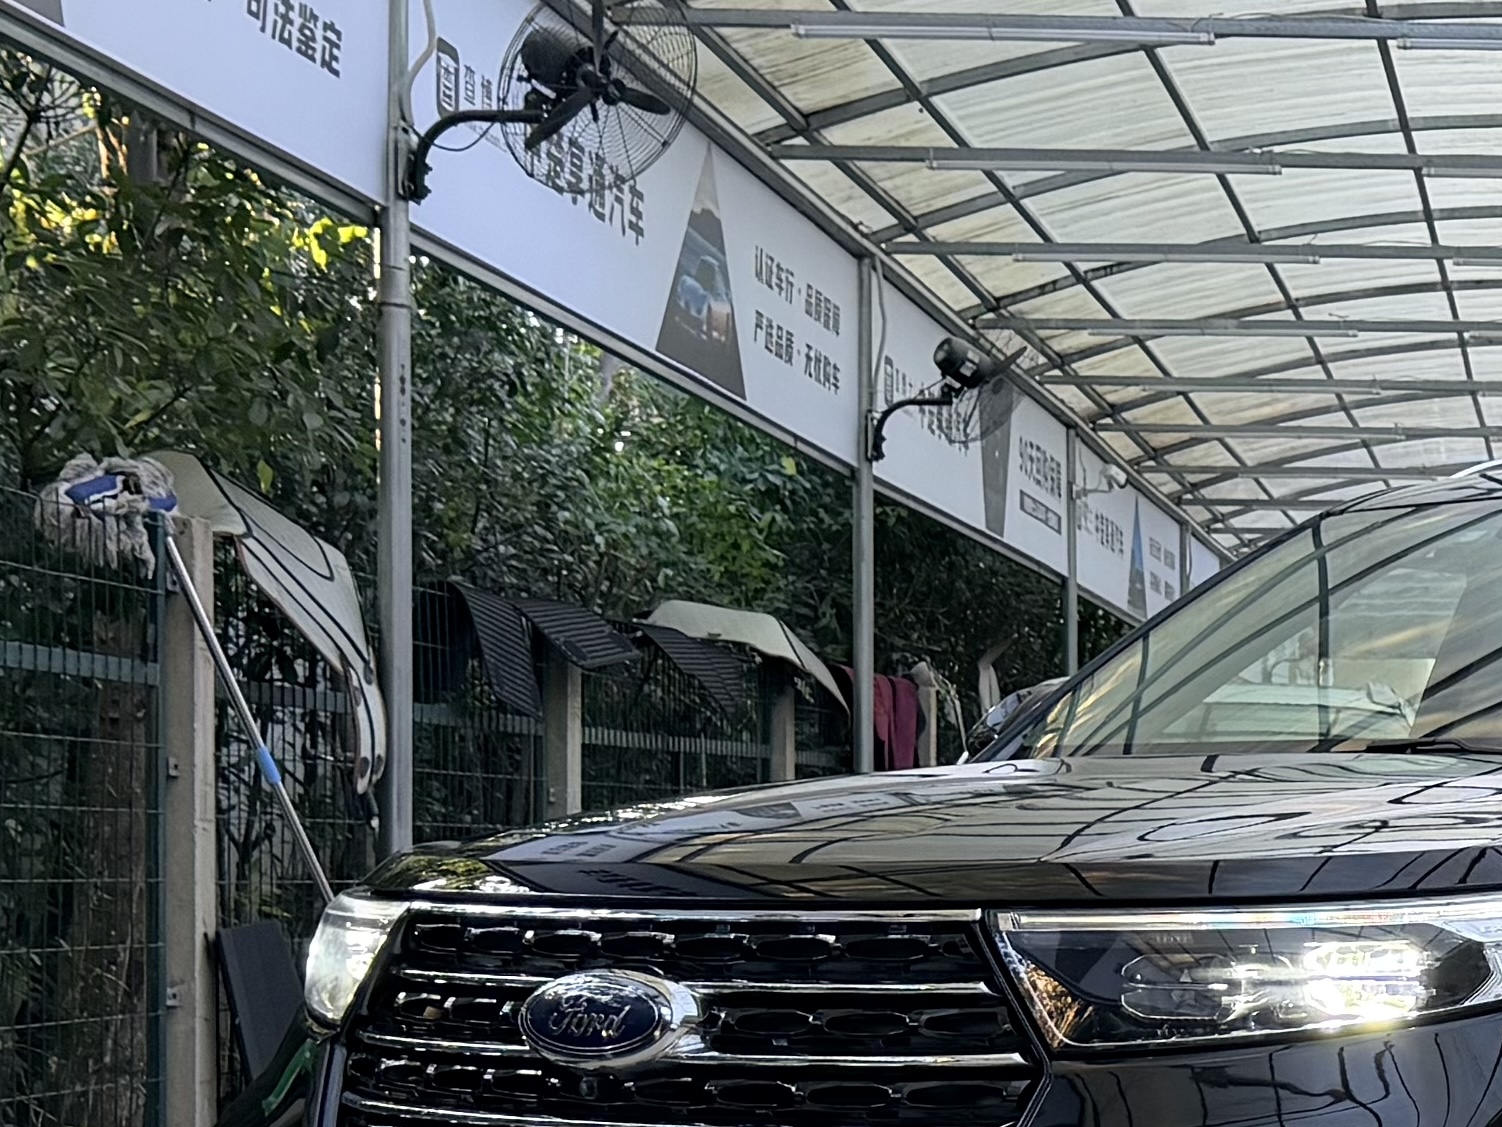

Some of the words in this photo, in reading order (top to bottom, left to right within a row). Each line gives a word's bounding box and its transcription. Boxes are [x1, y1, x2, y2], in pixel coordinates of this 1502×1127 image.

[246, 0, 341, 78] 司法鉴定
[550, 994, 632, 1037] Ford
